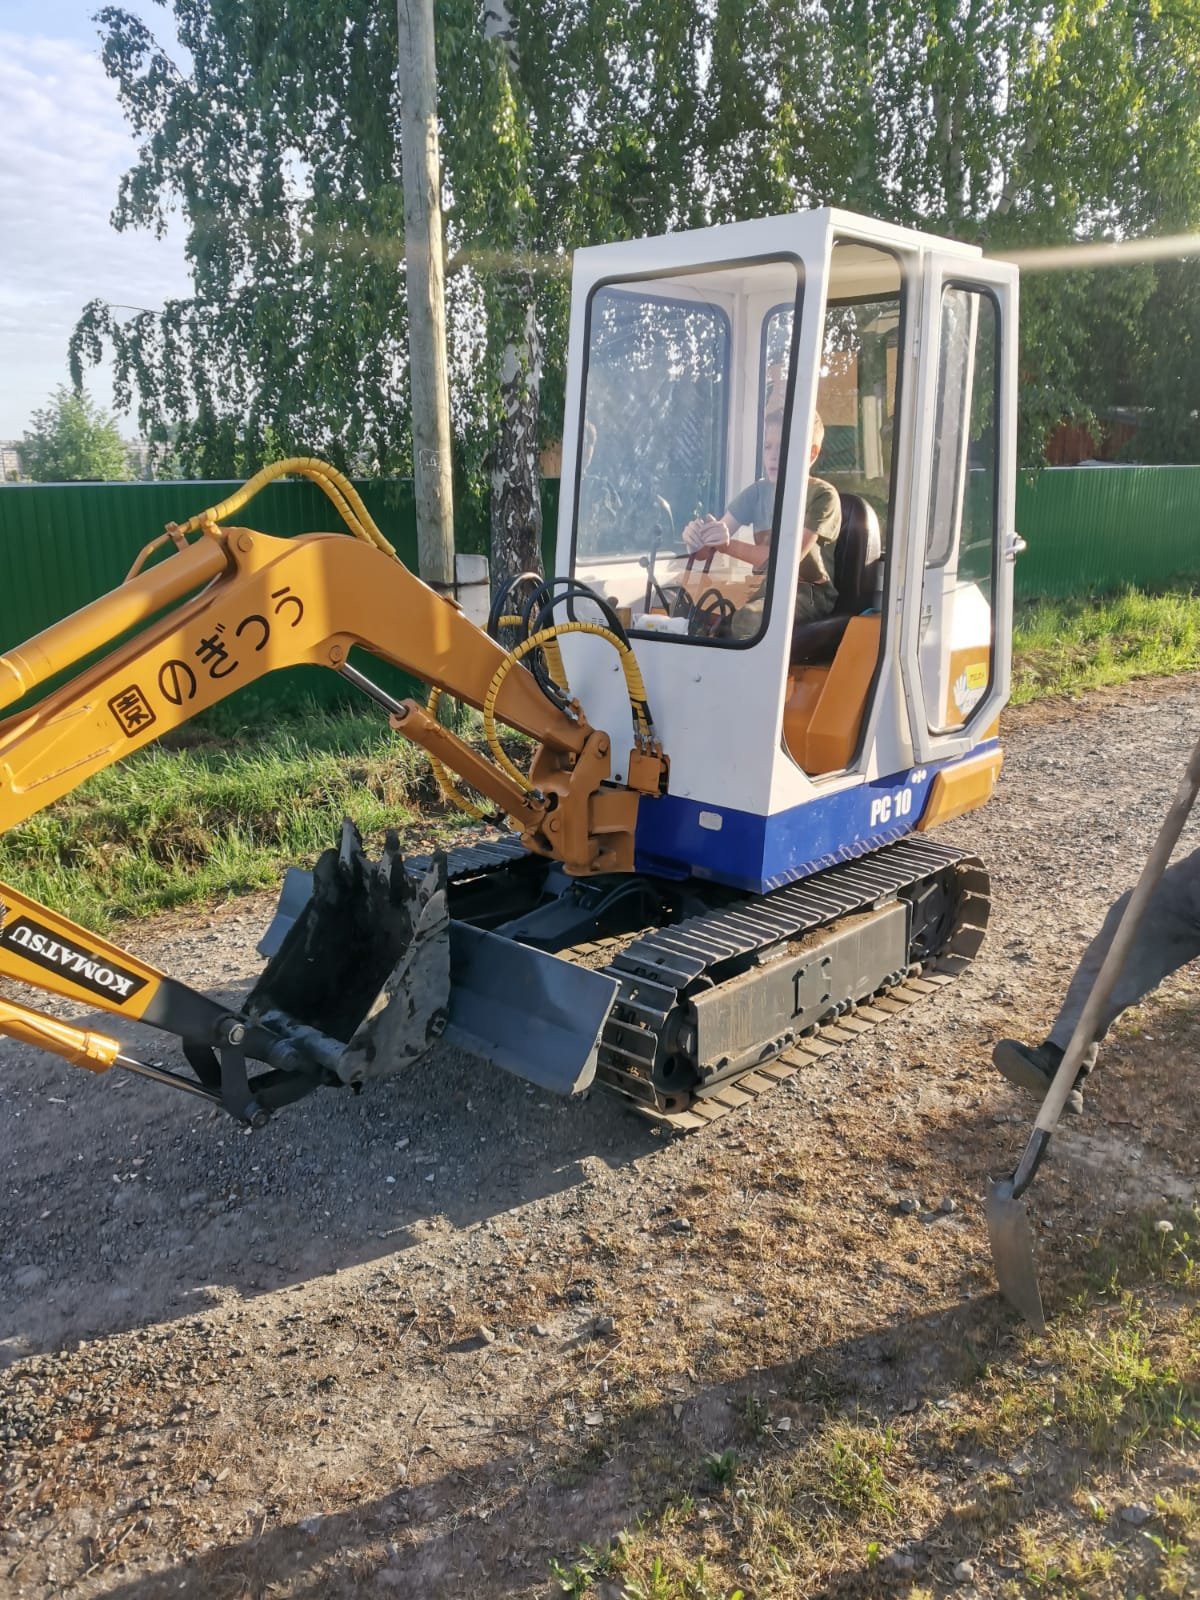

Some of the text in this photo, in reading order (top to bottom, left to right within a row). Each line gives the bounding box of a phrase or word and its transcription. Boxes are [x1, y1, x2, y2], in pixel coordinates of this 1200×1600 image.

[870, 788, 912, 827] PC 10
[8, 926, 134, 997] KOMATSU
